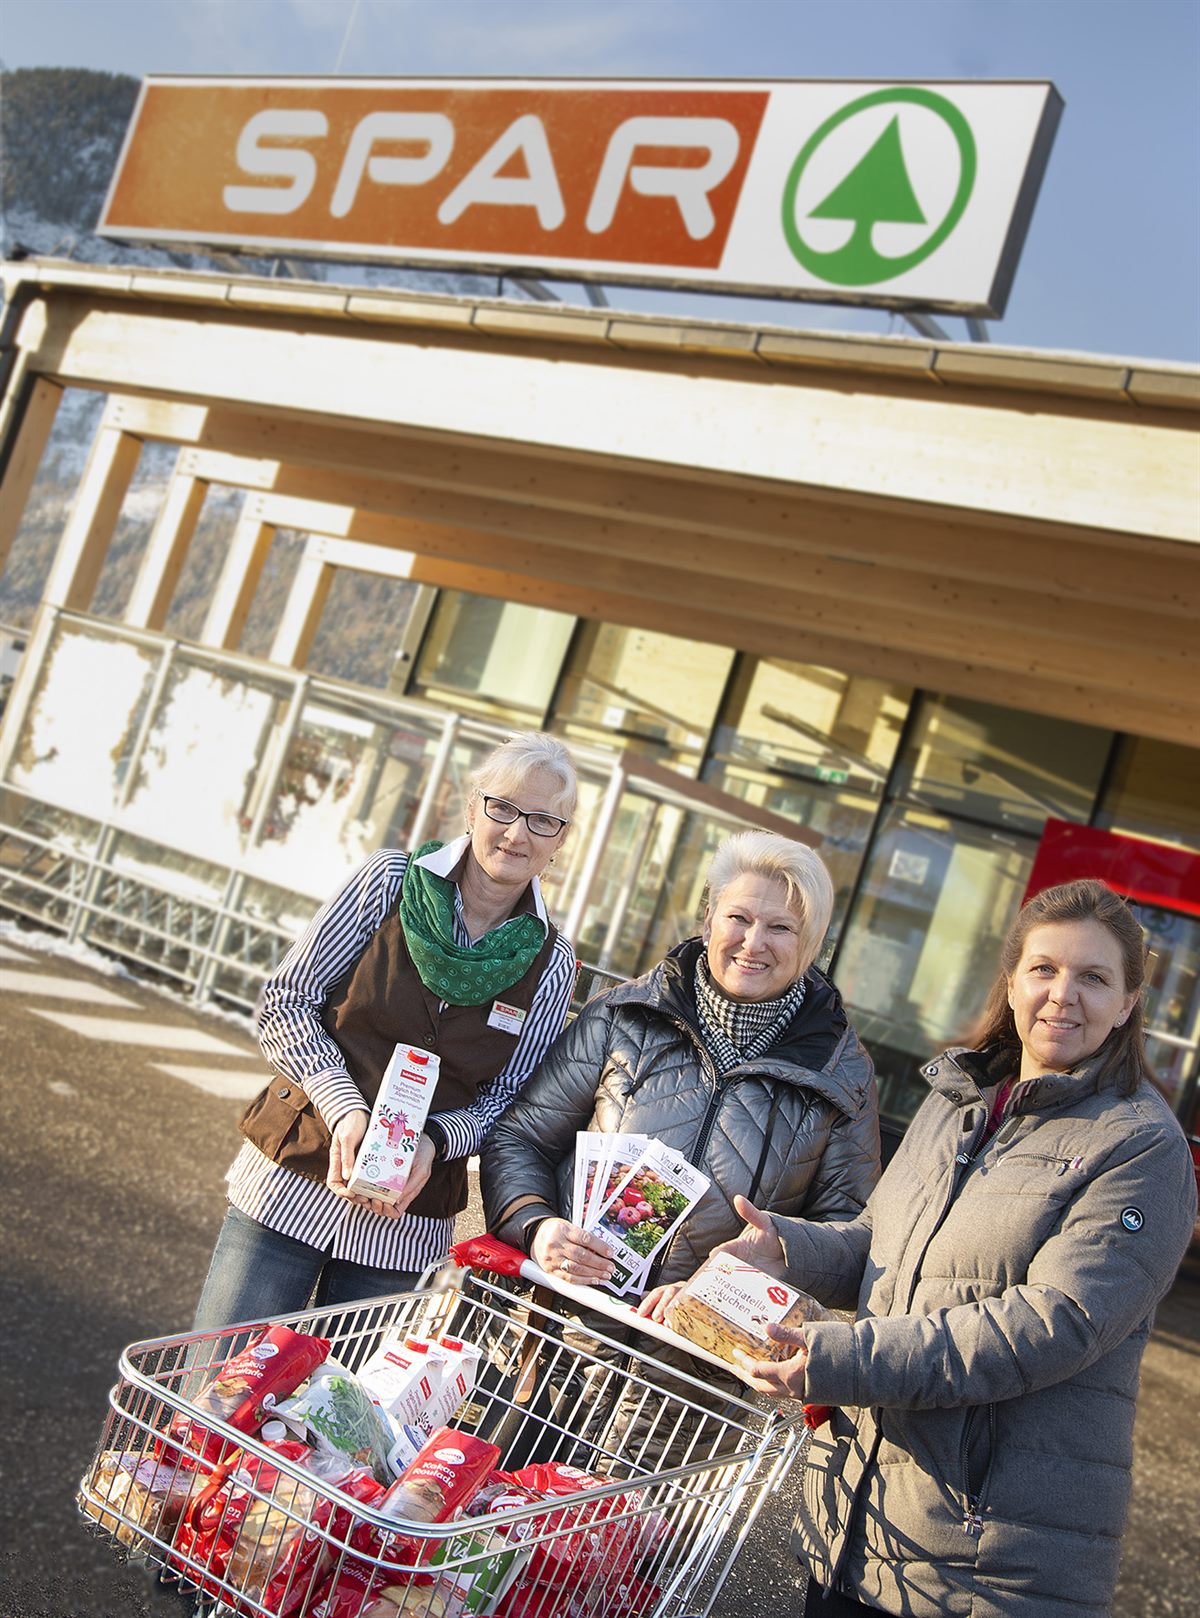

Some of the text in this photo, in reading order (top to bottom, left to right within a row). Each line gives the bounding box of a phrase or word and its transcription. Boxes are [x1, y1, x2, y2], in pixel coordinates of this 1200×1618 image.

[222, 108, 741, 240] SPAR
[660, 1151, 677, 1171] Vinzi
[680, 1168, 696, 1187] Tisch
[624, 1252, 641, 1271] Tisch
[612, 1269, 627, 1283] EN
[412, 1467, 455, 1489] Roulade
[422, 1461, 456, 1479] Kakao
